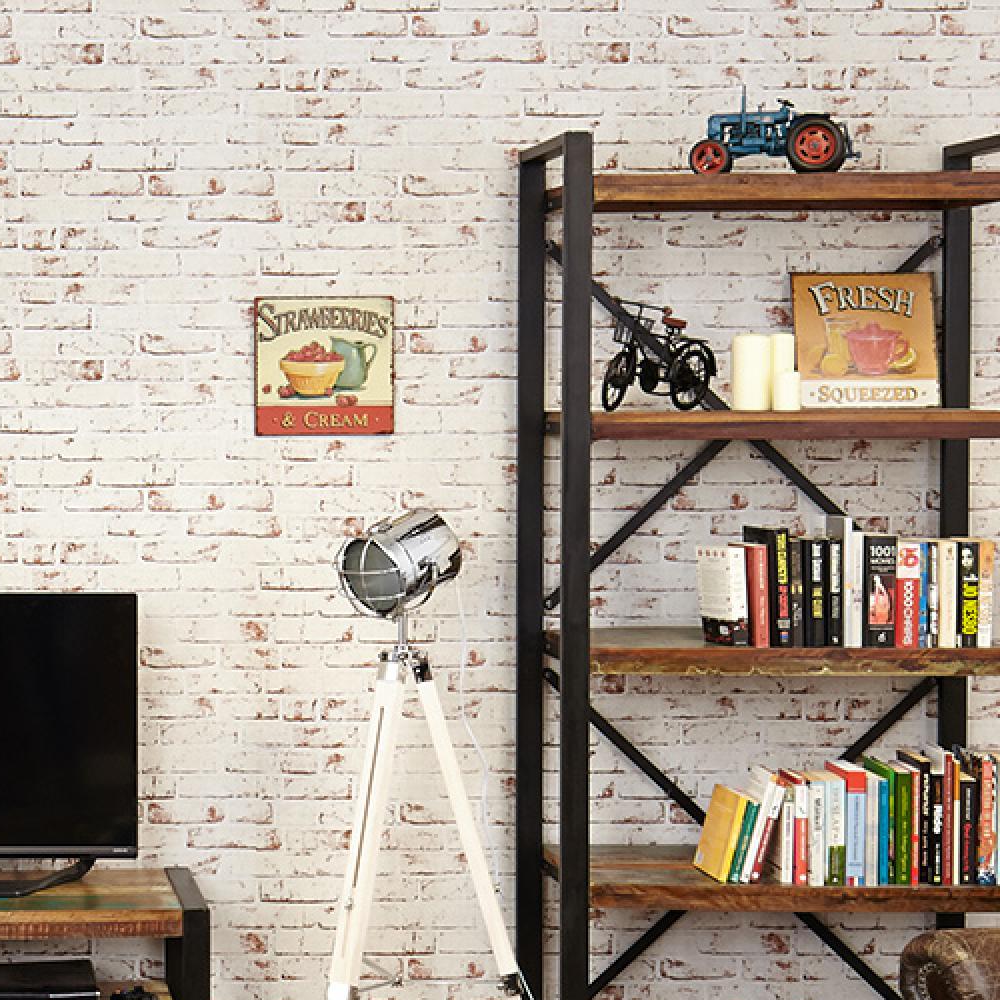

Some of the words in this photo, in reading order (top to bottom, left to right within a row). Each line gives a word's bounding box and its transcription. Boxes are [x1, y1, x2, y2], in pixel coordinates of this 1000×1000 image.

[807, 281, 915, 318] FRESH
[257, 303, 389, 342] STRAWBERRIES
[817, 383, 919, 404] SQUEEZED
[280, 411, 297, 429] &
[303, 410, 370, 429] CREAM
